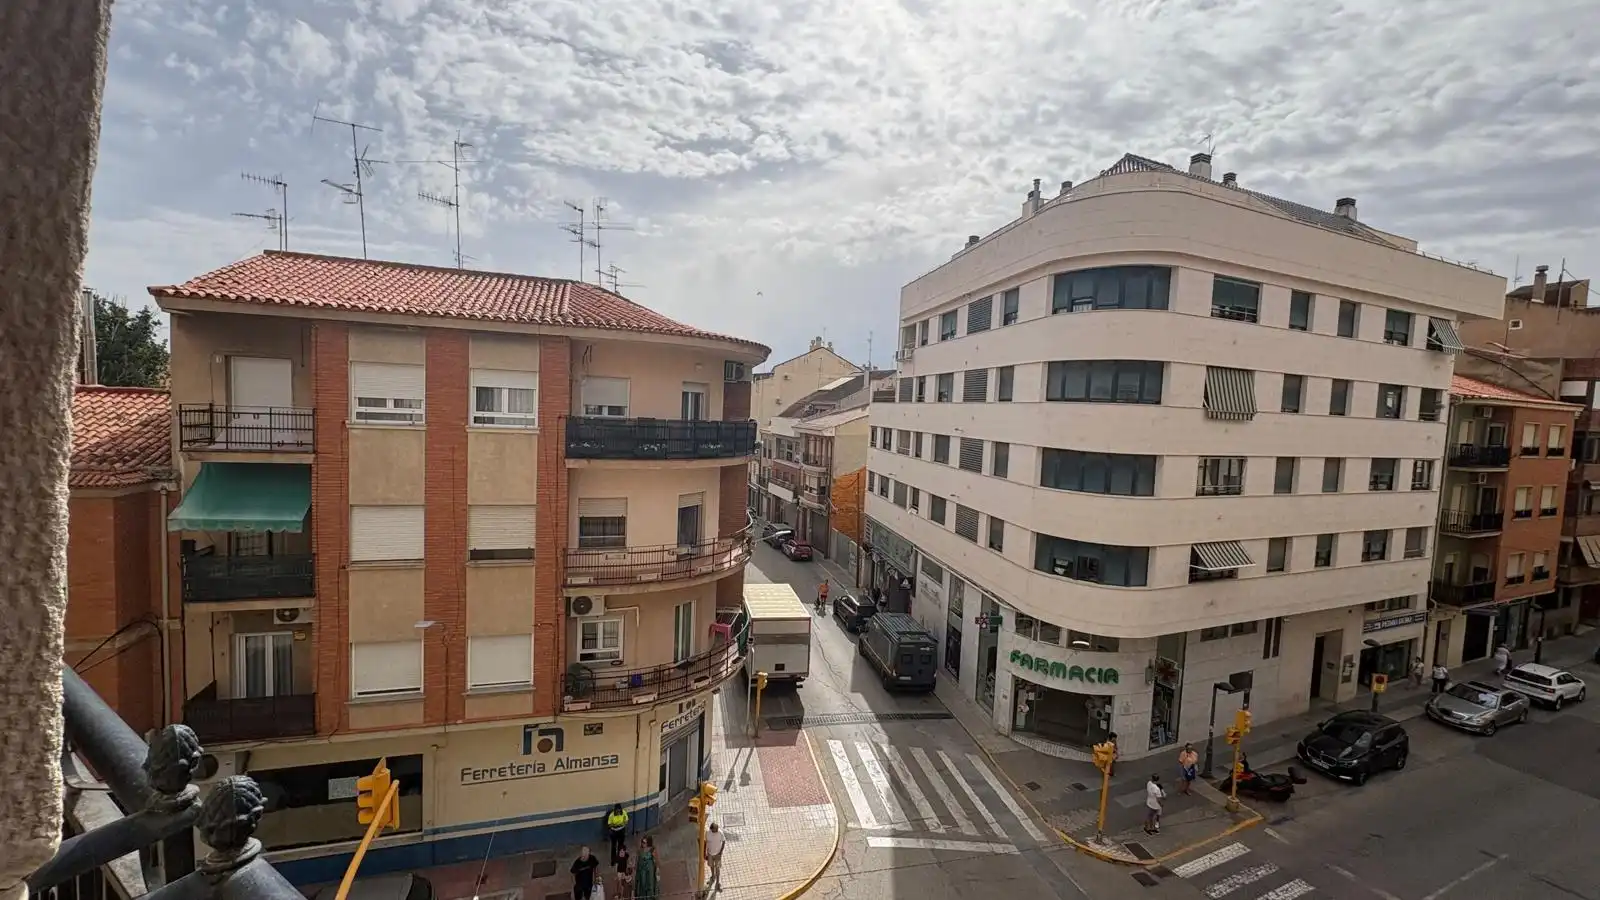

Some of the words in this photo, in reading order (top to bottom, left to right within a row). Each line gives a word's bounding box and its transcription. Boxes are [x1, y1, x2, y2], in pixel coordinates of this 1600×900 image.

[1010, 649, 1120, 684] FARMACIA
[461, 761, 546, 782] Ferretería
[553, 754, 619, 771] Almansa
